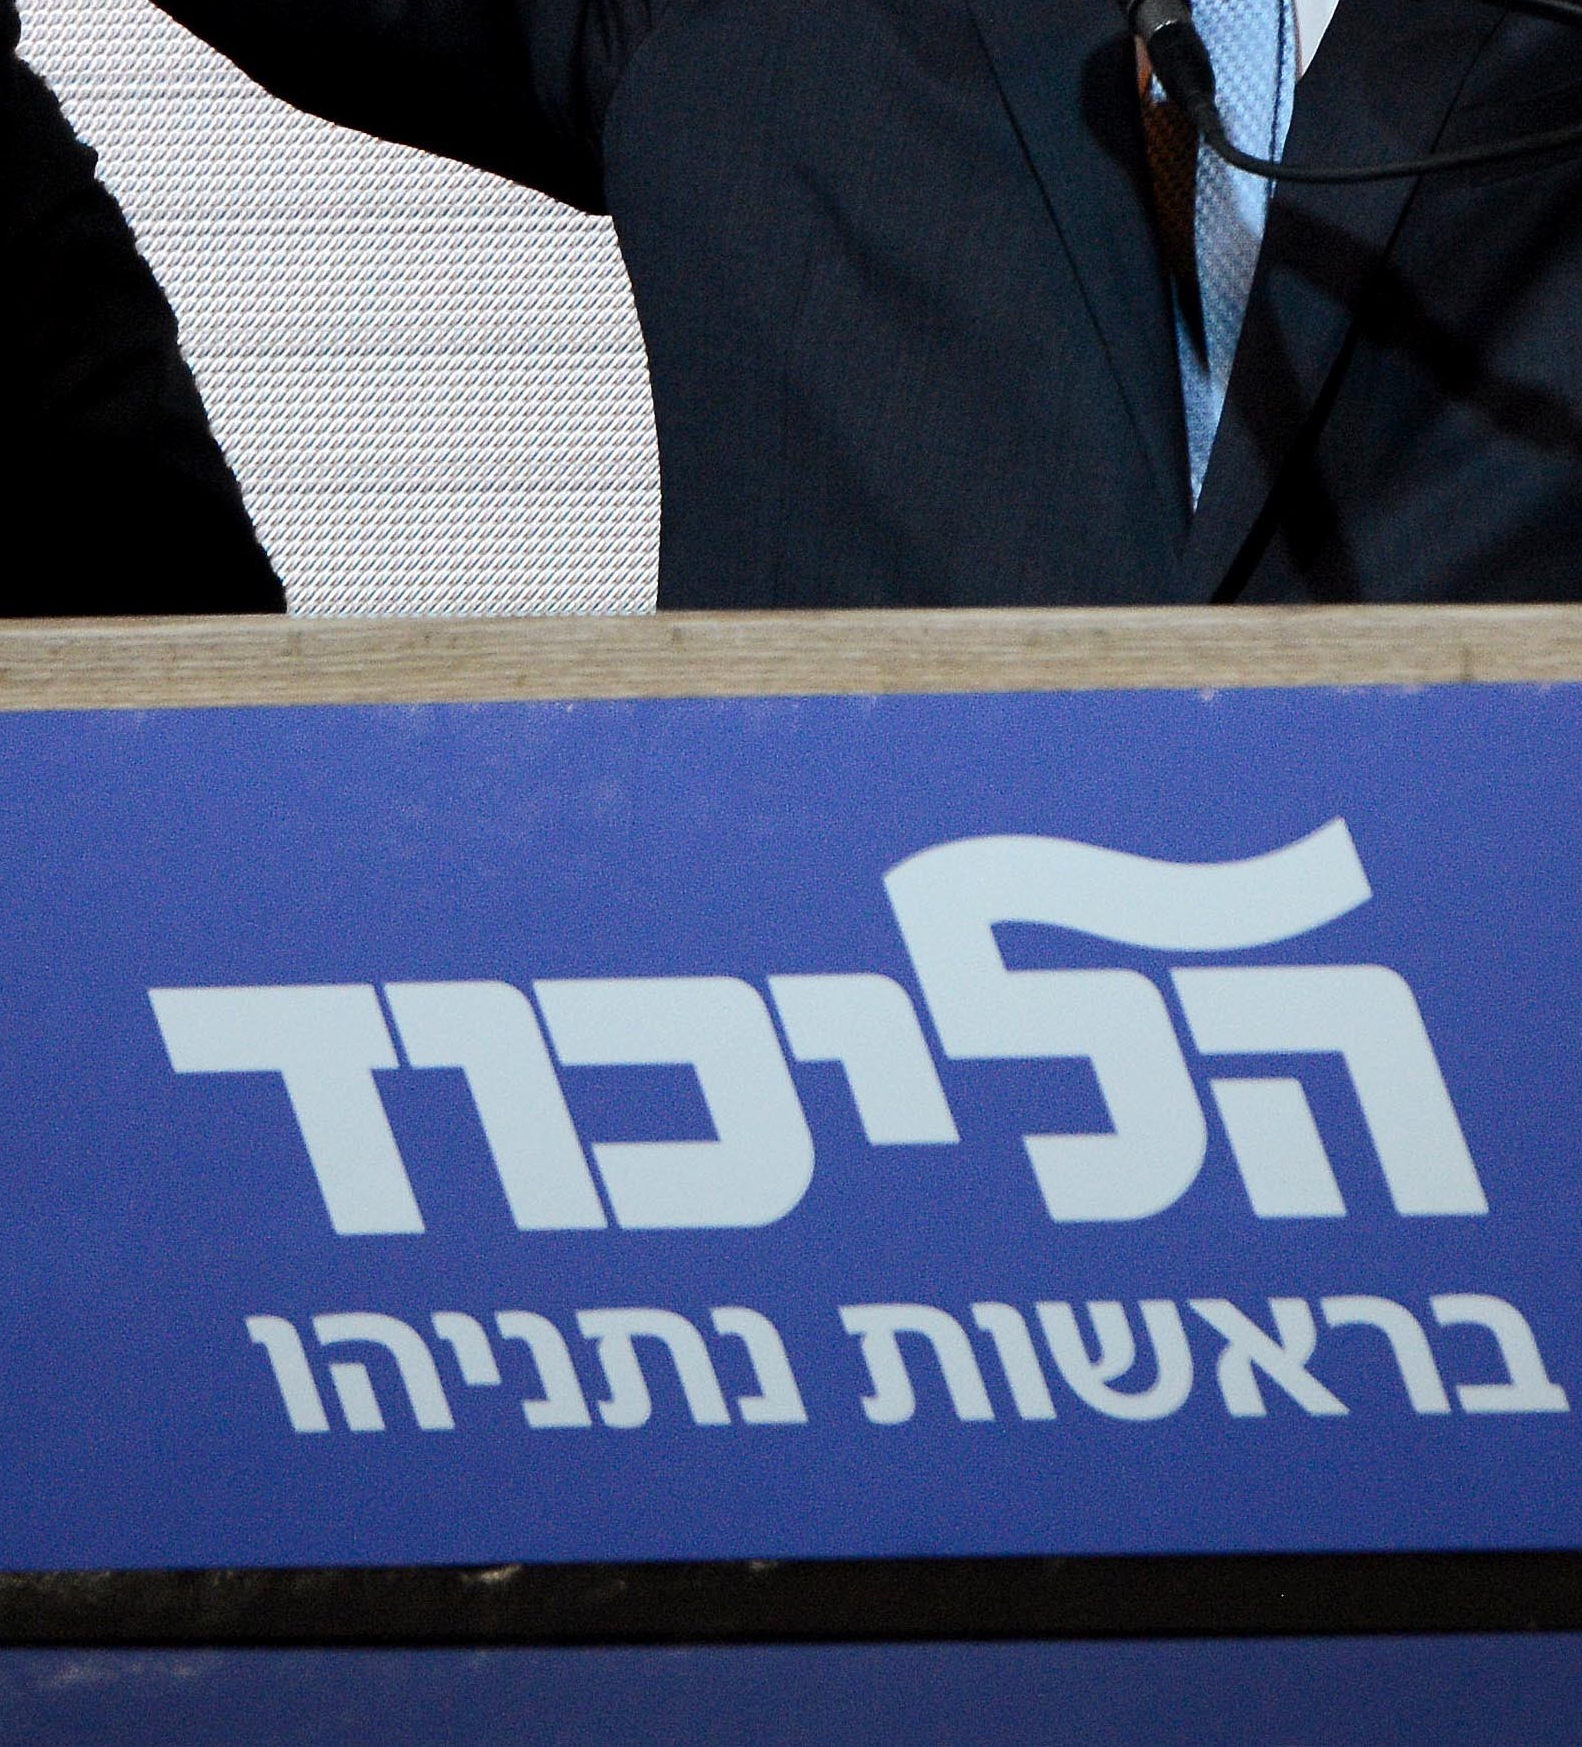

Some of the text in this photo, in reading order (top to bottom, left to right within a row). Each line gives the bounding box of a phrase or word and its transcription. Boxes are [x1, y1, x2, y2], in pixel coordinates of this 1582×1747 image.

[148, 817, 1489, 1235] הליכוד
[246, 1294, 1569, 1432] בראשות נתניהו
